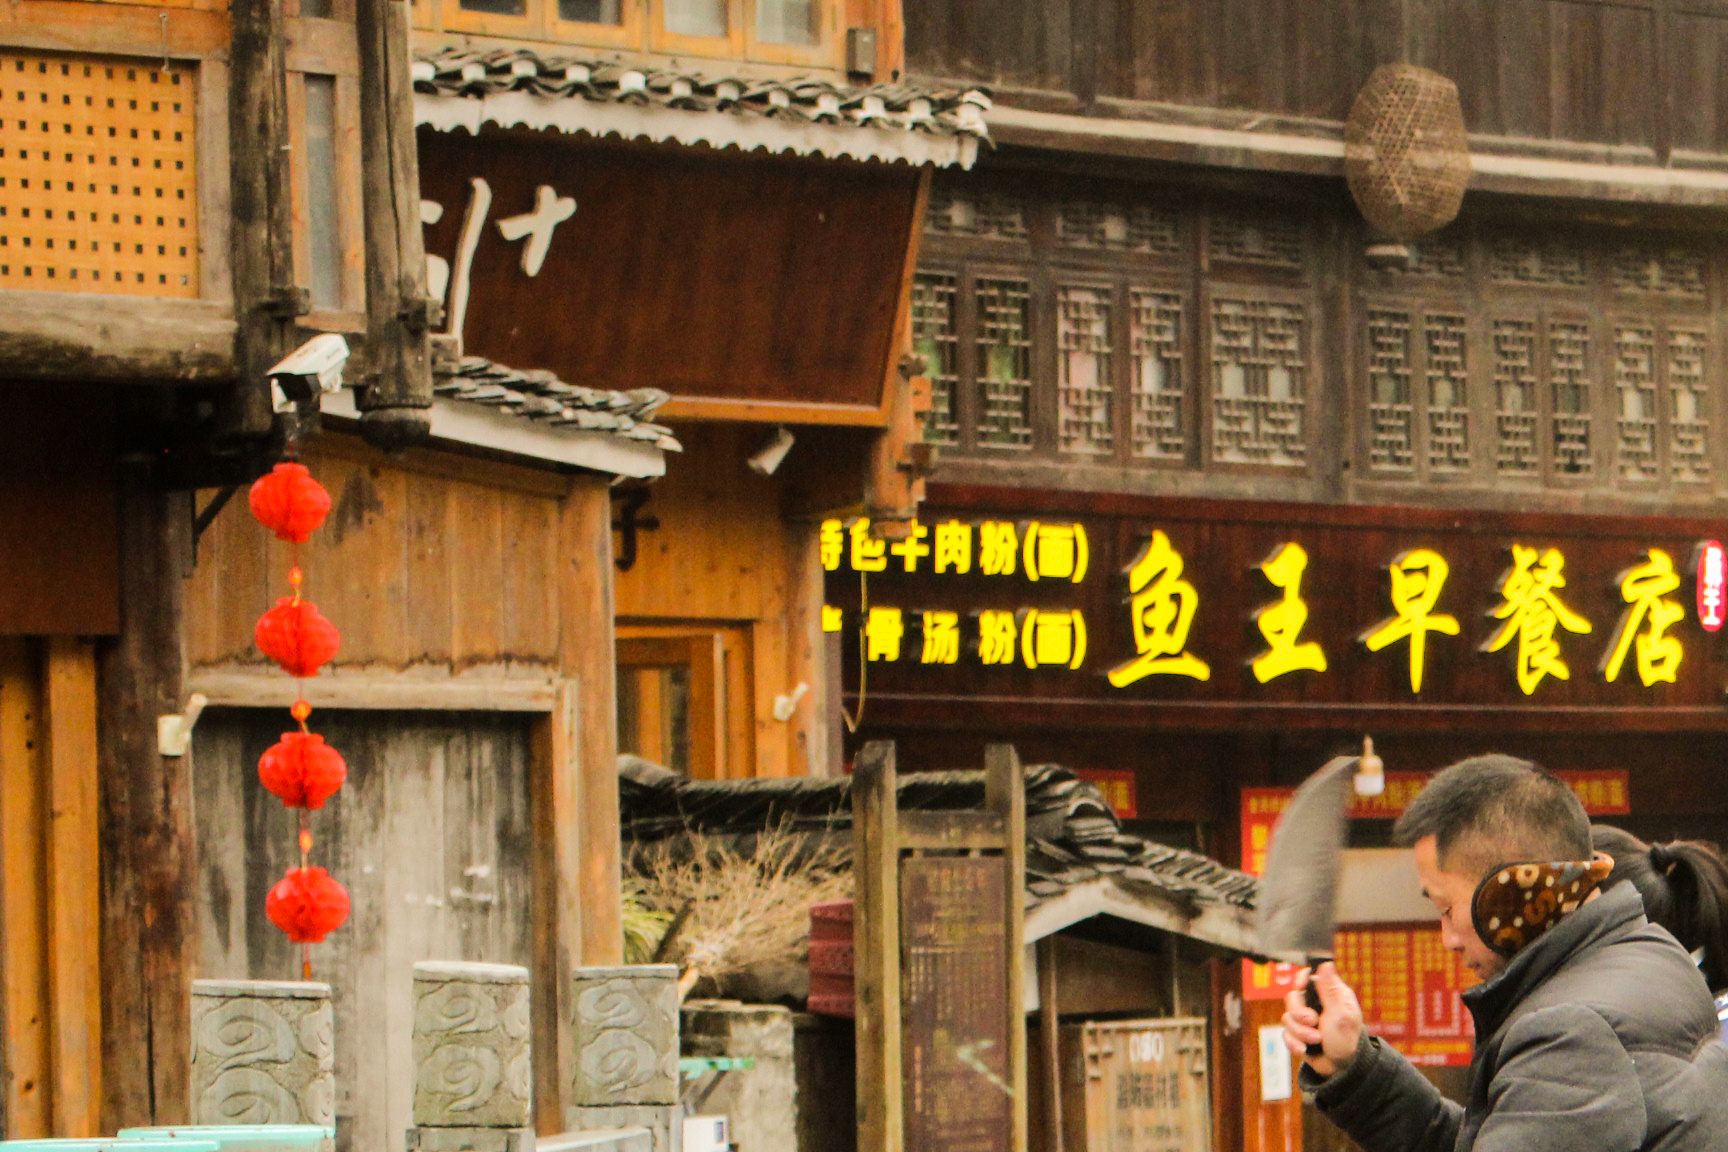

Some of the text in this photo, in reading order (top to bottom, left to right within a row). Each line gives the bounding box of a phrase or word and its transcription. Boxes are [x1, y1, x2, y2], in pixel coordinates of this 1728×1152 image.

[821, 604, 1088, 671] 骨汤粉(面)
[1107, 530, 1687, 697] 鱼王早餐店
